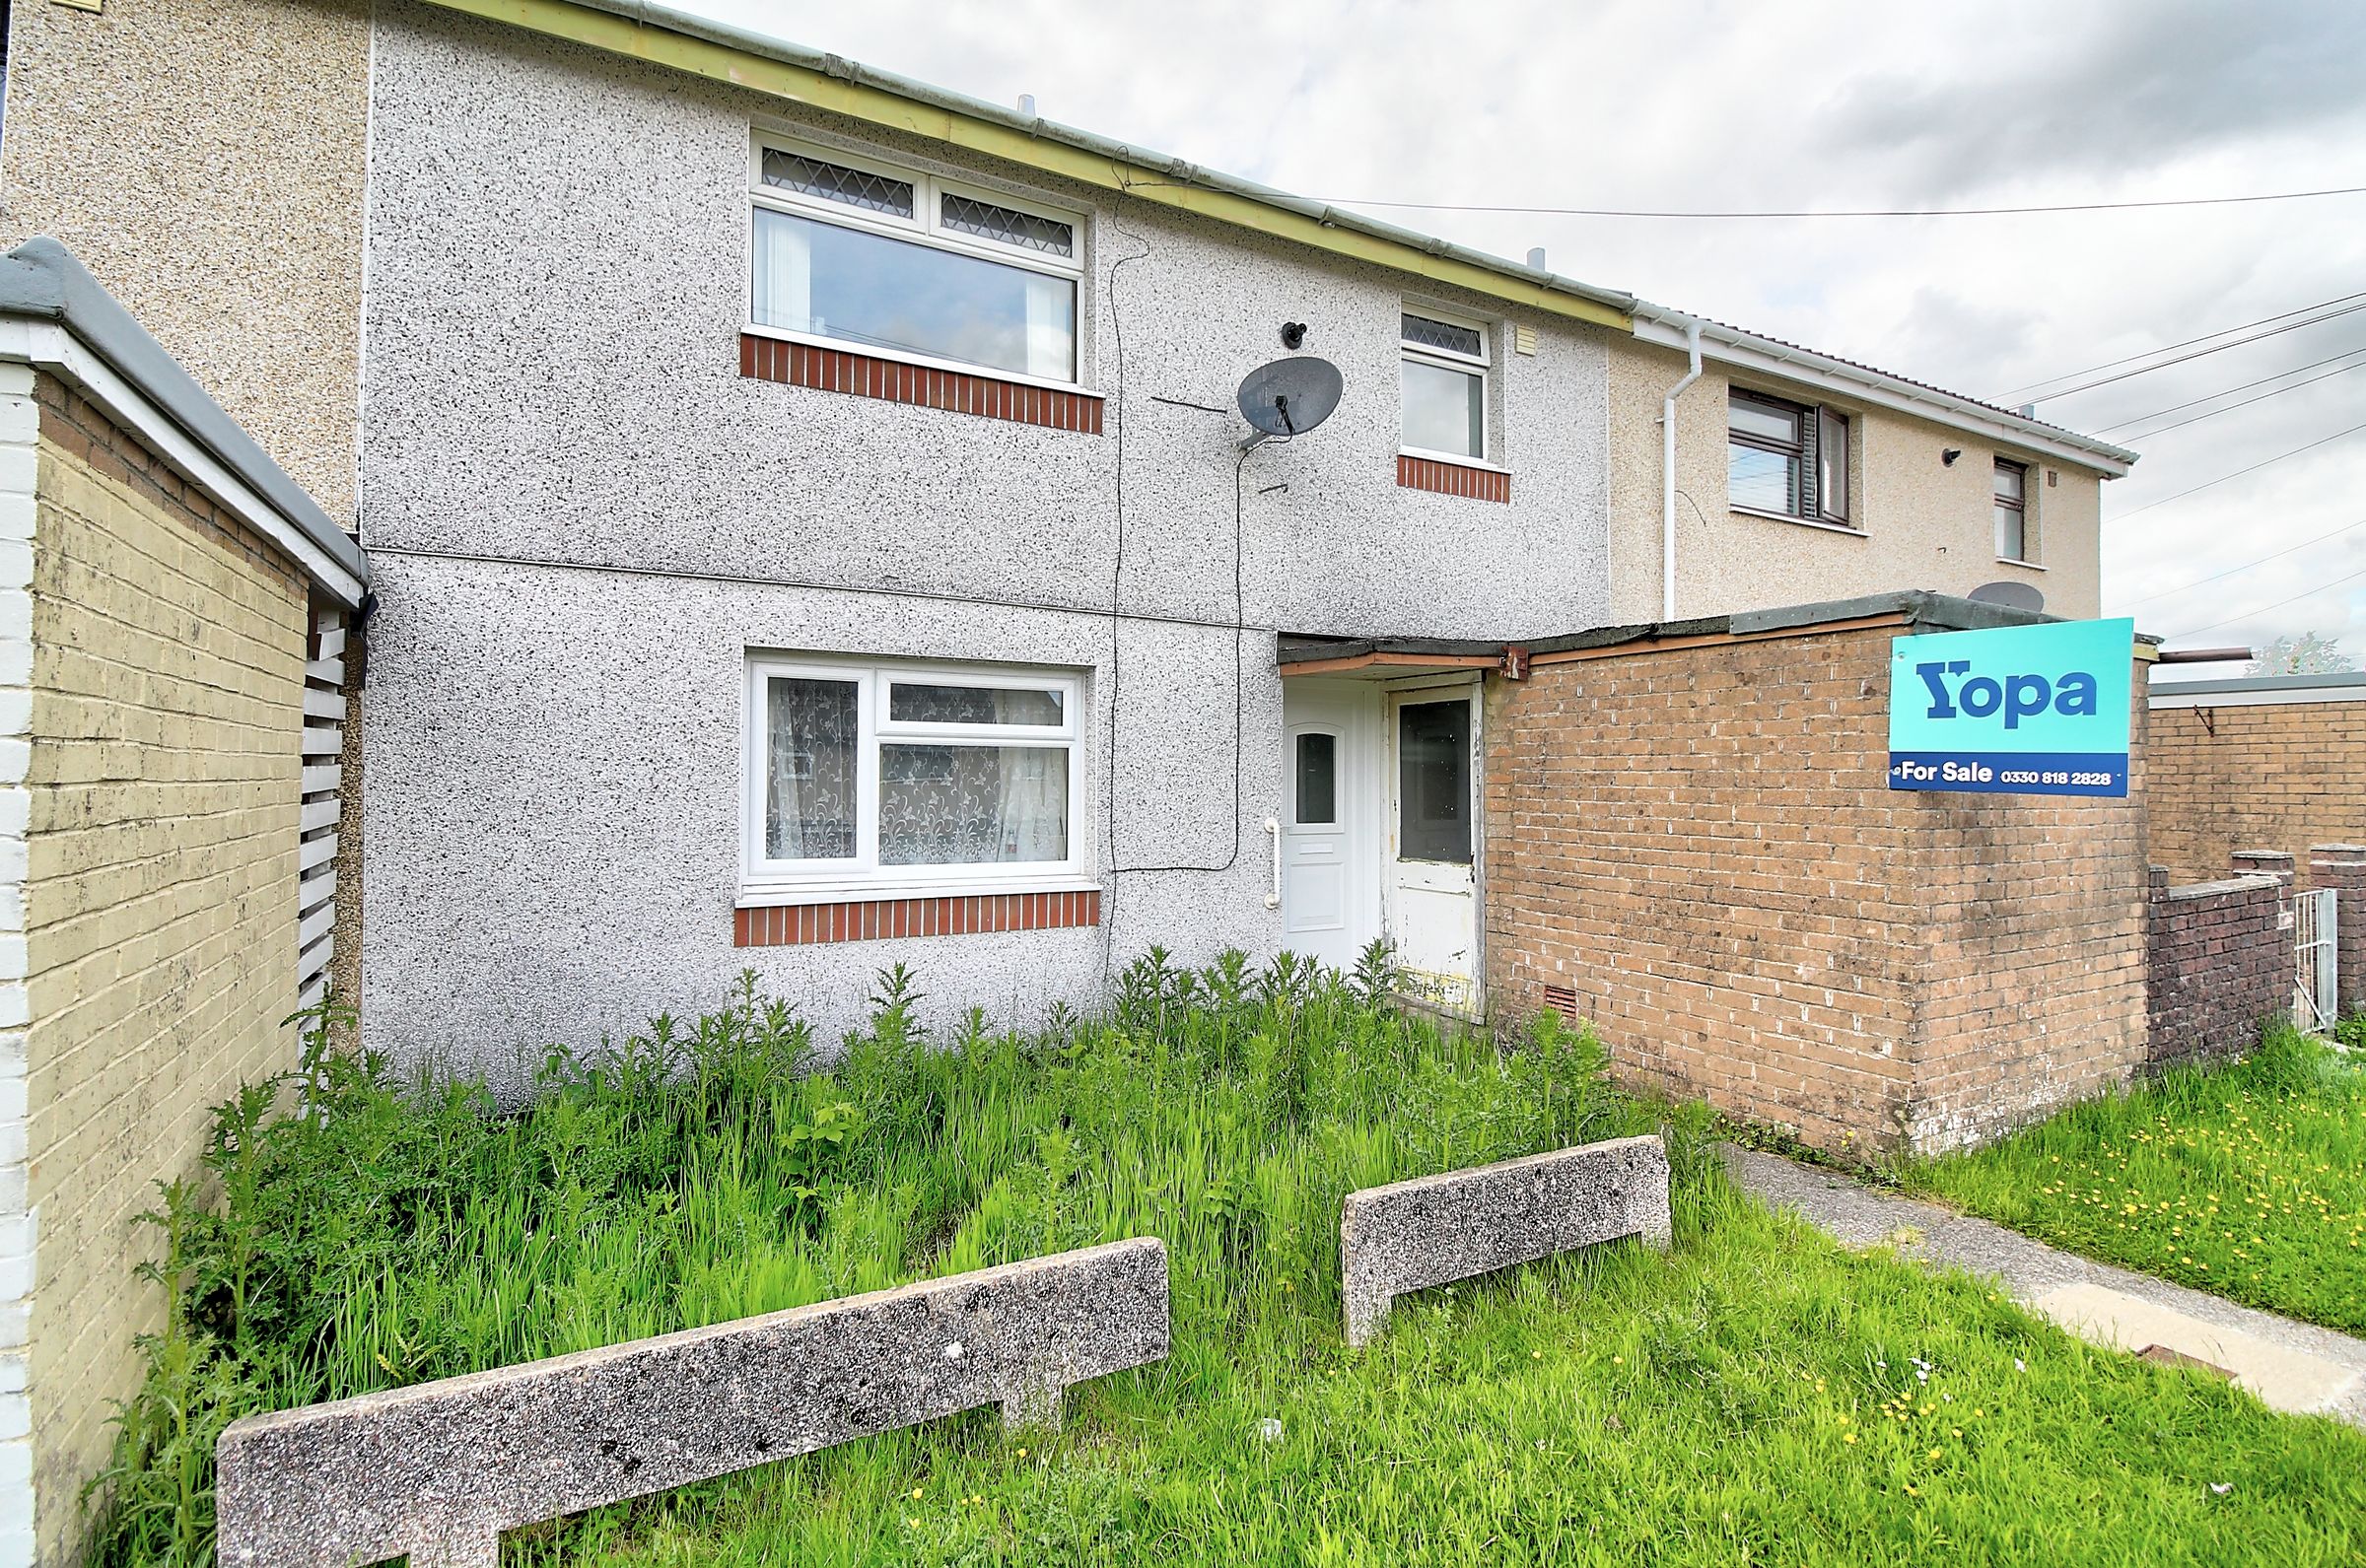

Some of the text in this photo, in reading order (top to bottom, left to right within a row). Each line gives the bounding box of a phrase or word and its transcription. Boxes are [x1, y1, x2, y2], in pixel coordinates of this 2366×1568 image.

[1915, 660, 2097, 729] Yopa
[1901, 761, 2112, 785] For Sale 0330 818 2828
